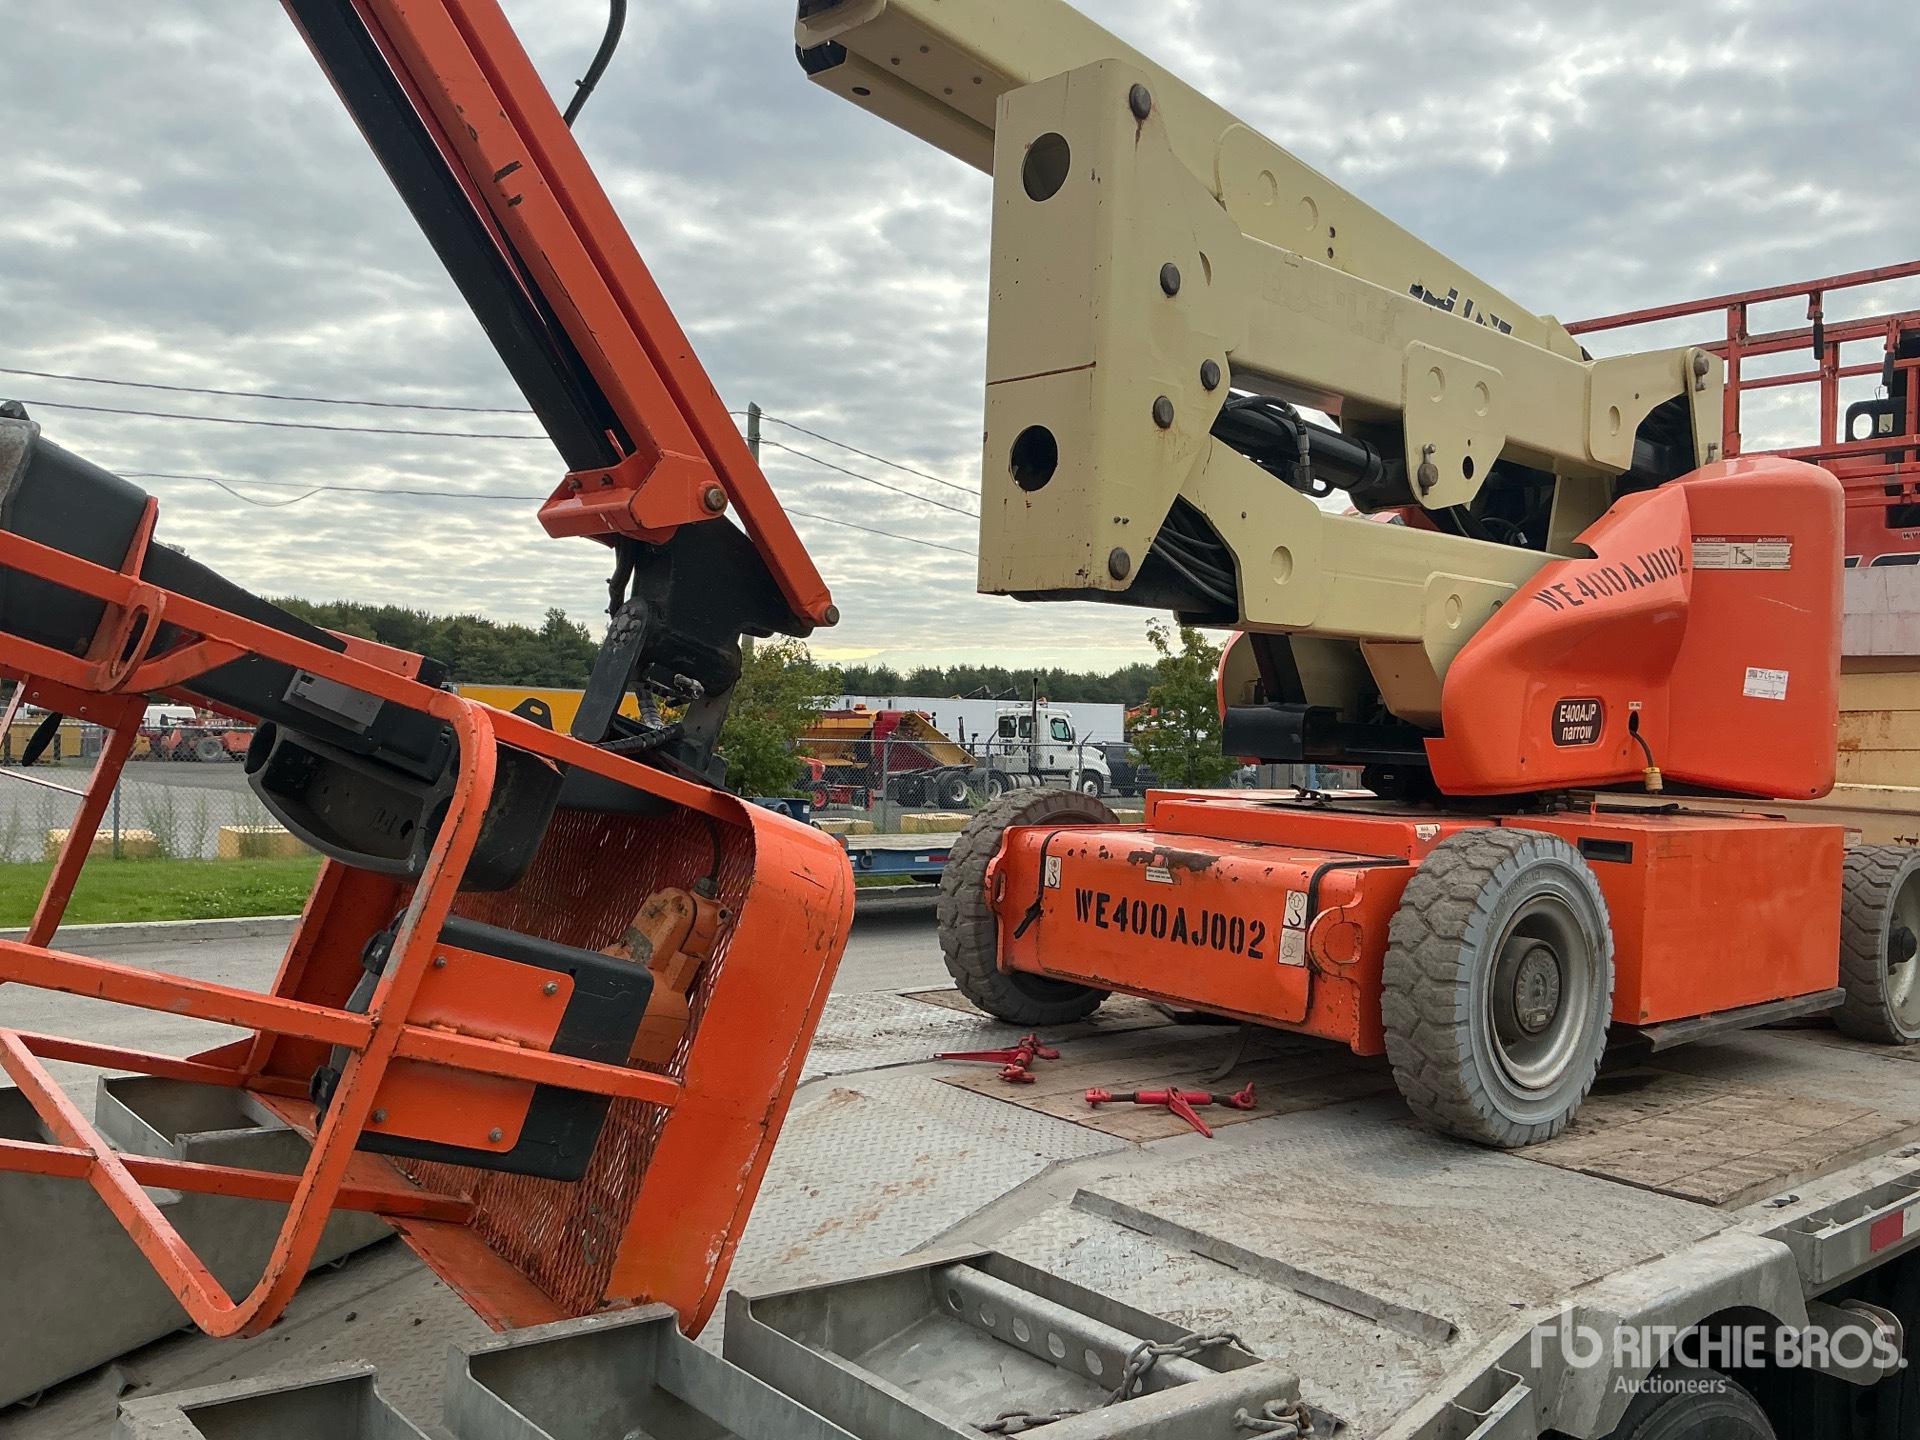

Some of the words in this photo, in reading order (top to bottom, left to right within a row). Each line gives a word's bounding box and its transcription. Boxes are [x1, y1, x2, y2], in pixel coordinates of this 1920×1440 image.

[1530, 545, 1688, 611] WE400AJ002
[1559, 703, 1597, 723] E400AJP
[1562, 725, 1593, 741] narrow
[1075, 887, 1267, 960] WE400AJ002
